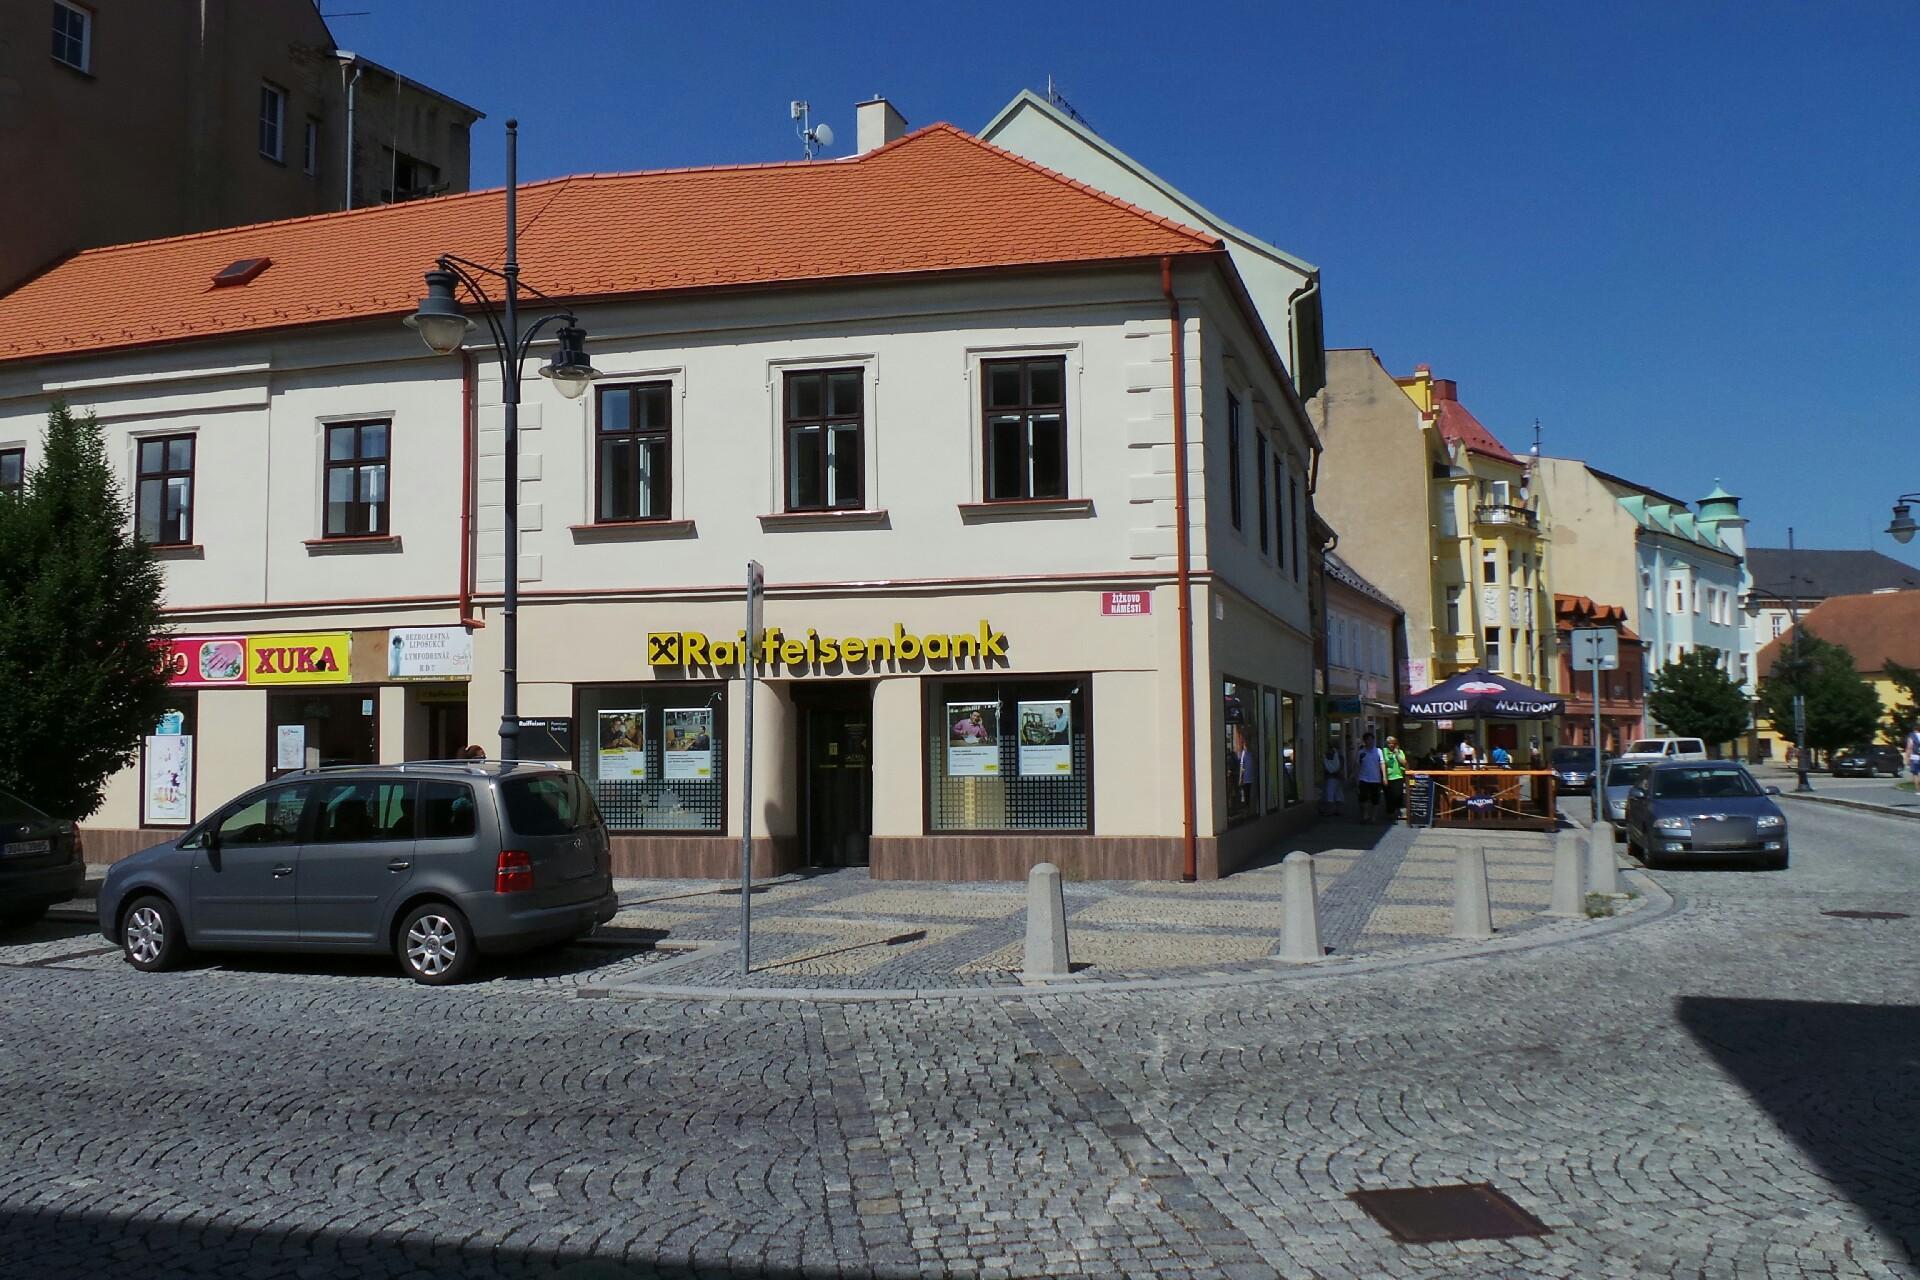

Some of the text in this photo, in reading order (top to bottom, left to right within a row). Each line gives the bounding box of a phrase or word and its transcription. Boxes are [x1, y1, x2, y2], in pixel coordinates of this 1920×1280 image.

[1112, 592, 1141, 603] ŽIŽKOVO
[1111, 602, 1142, 614] NÁMĚSTÍ
[254, 646, 340, 674] XUKA
[1410, 699, 1468, 714] MATTONI
[1495, 700, 1557, 714] MATTONI
